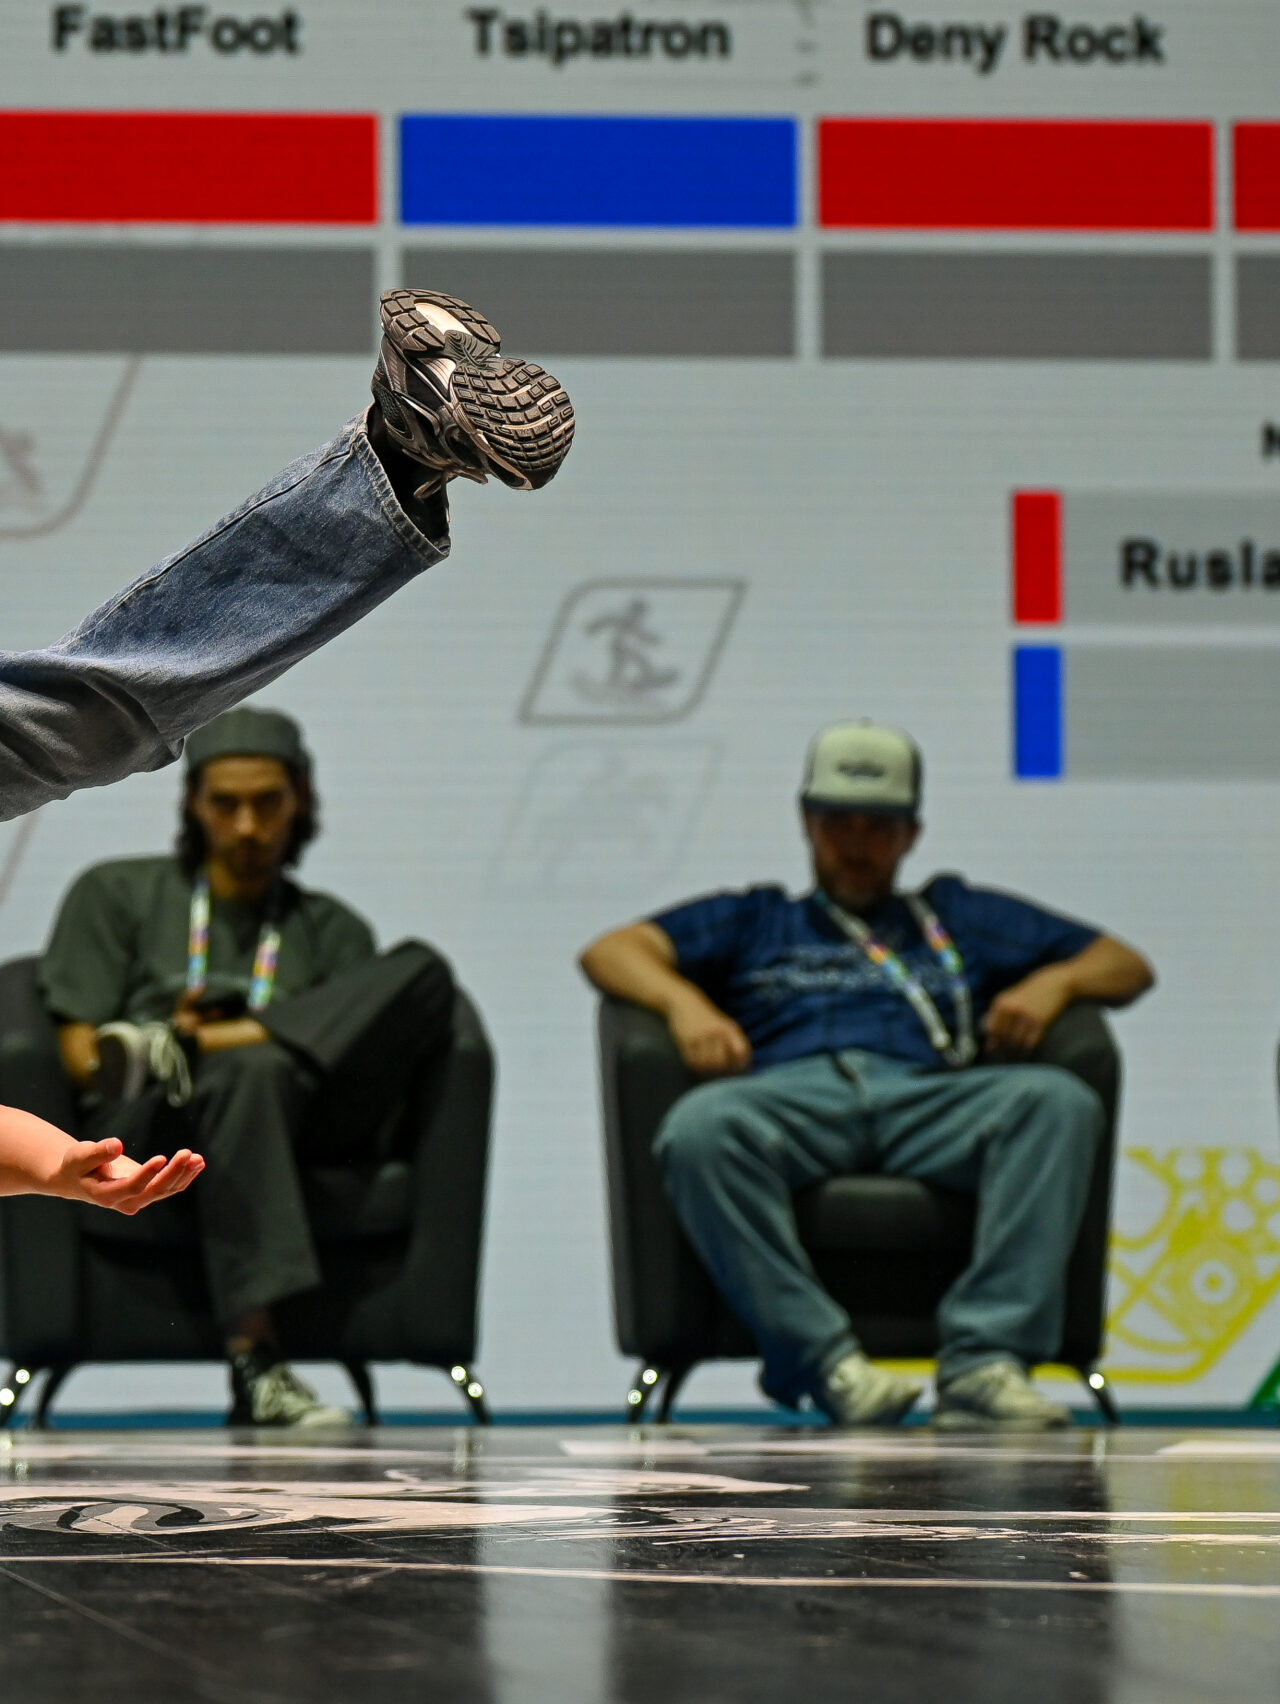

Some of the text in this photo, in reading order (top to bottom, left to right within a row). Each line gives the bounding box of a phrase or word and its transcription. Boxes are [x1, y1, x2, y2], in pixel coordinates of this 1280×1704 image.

[54, 6, 297, 52] FastFoot
[469, 9, 729, 64] Tsipatron
[867, 14, 1162, 72] Deny Rock
